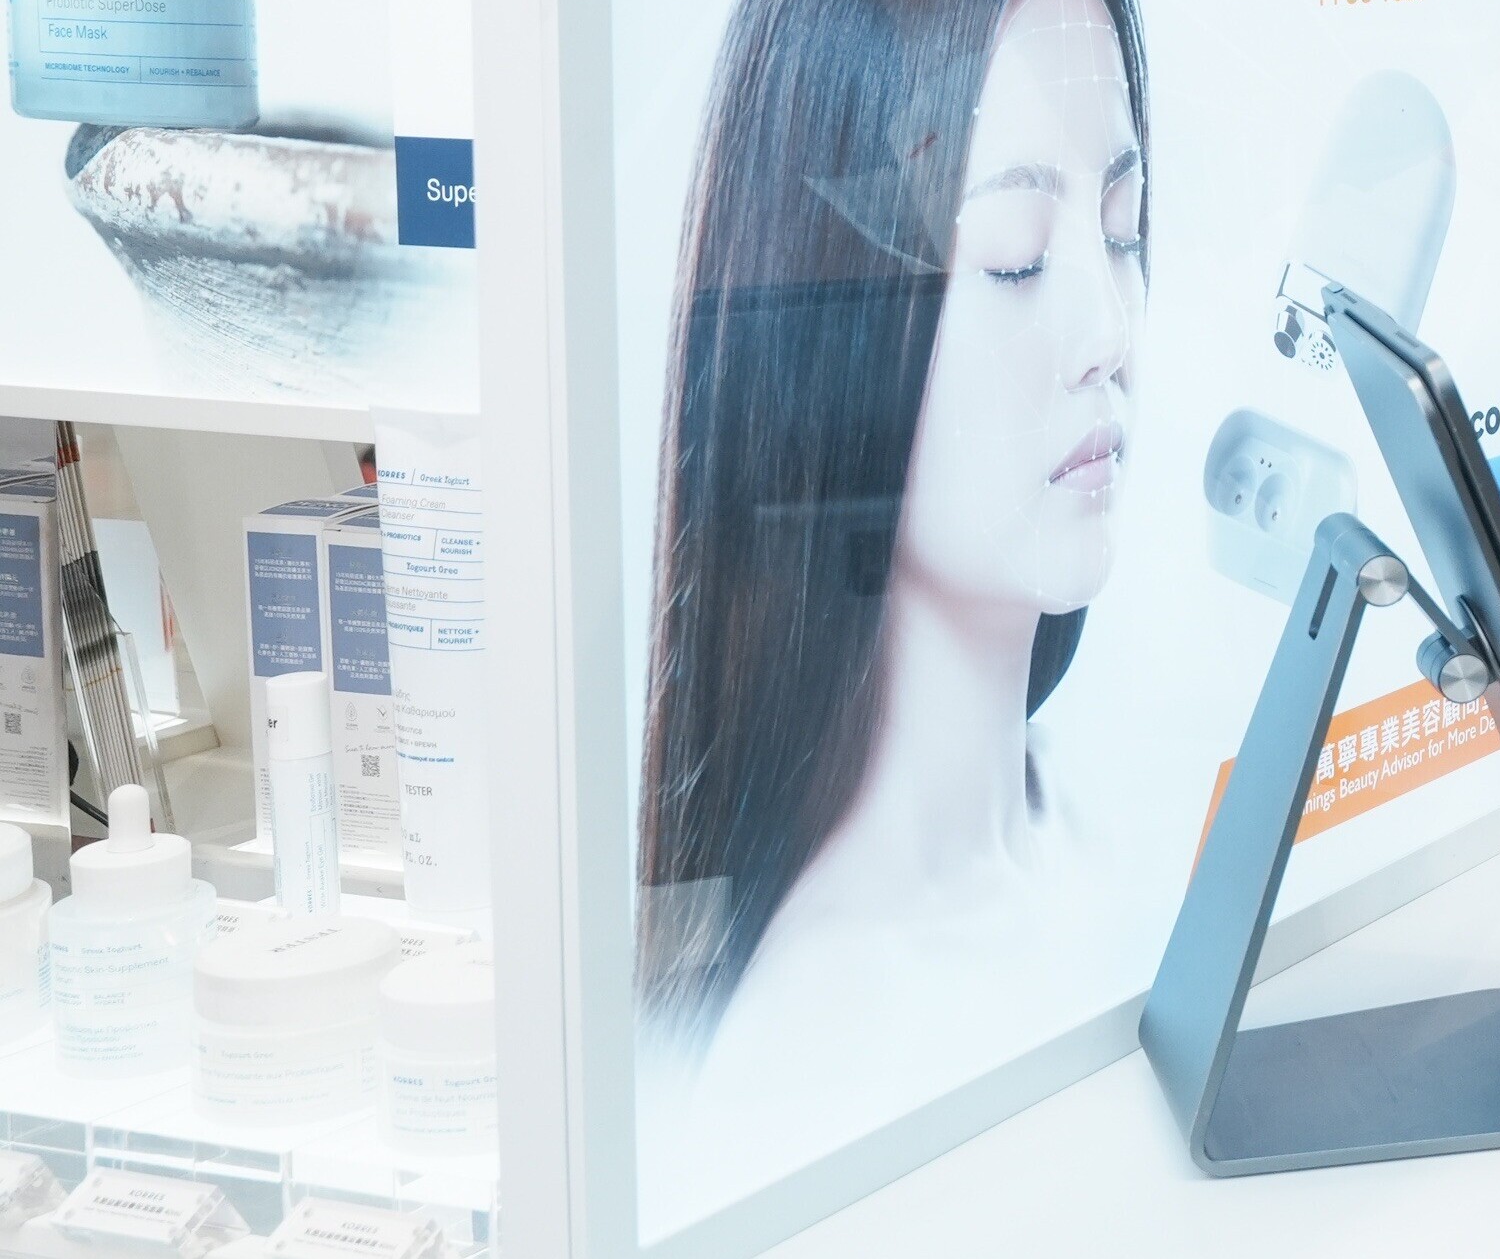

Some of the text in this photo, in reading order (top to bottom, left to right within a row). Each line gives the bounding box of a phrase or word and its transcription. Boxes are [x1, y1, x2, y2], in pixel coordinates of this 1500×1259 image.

[48, 24, 108, 40] Face Mask
[84, 64, 130, 75] TECHNOLOGY
[149, 67, 180, 77] NOURISH
[427, 178, 476, 207] Supe
[382, 494, 446, 510] Foaming Cream
[381, 508, 415, 521] Cleanser
[441, 537, 473, 546] CLEANSE
[440, 547, 472, 556] NOURISH
[401, 586, 449, 600] Nettoyante
[438, 627, 473, 636] NETTOIE
[438, 637, 474, 645] NOURRIT
[1316, 698, 1489, 784] 萬寧專業美容顧問
[1303, 714, 1496, 816] nings Beauty Advisor for More De
[405, 784, 432, 797] TESTER
